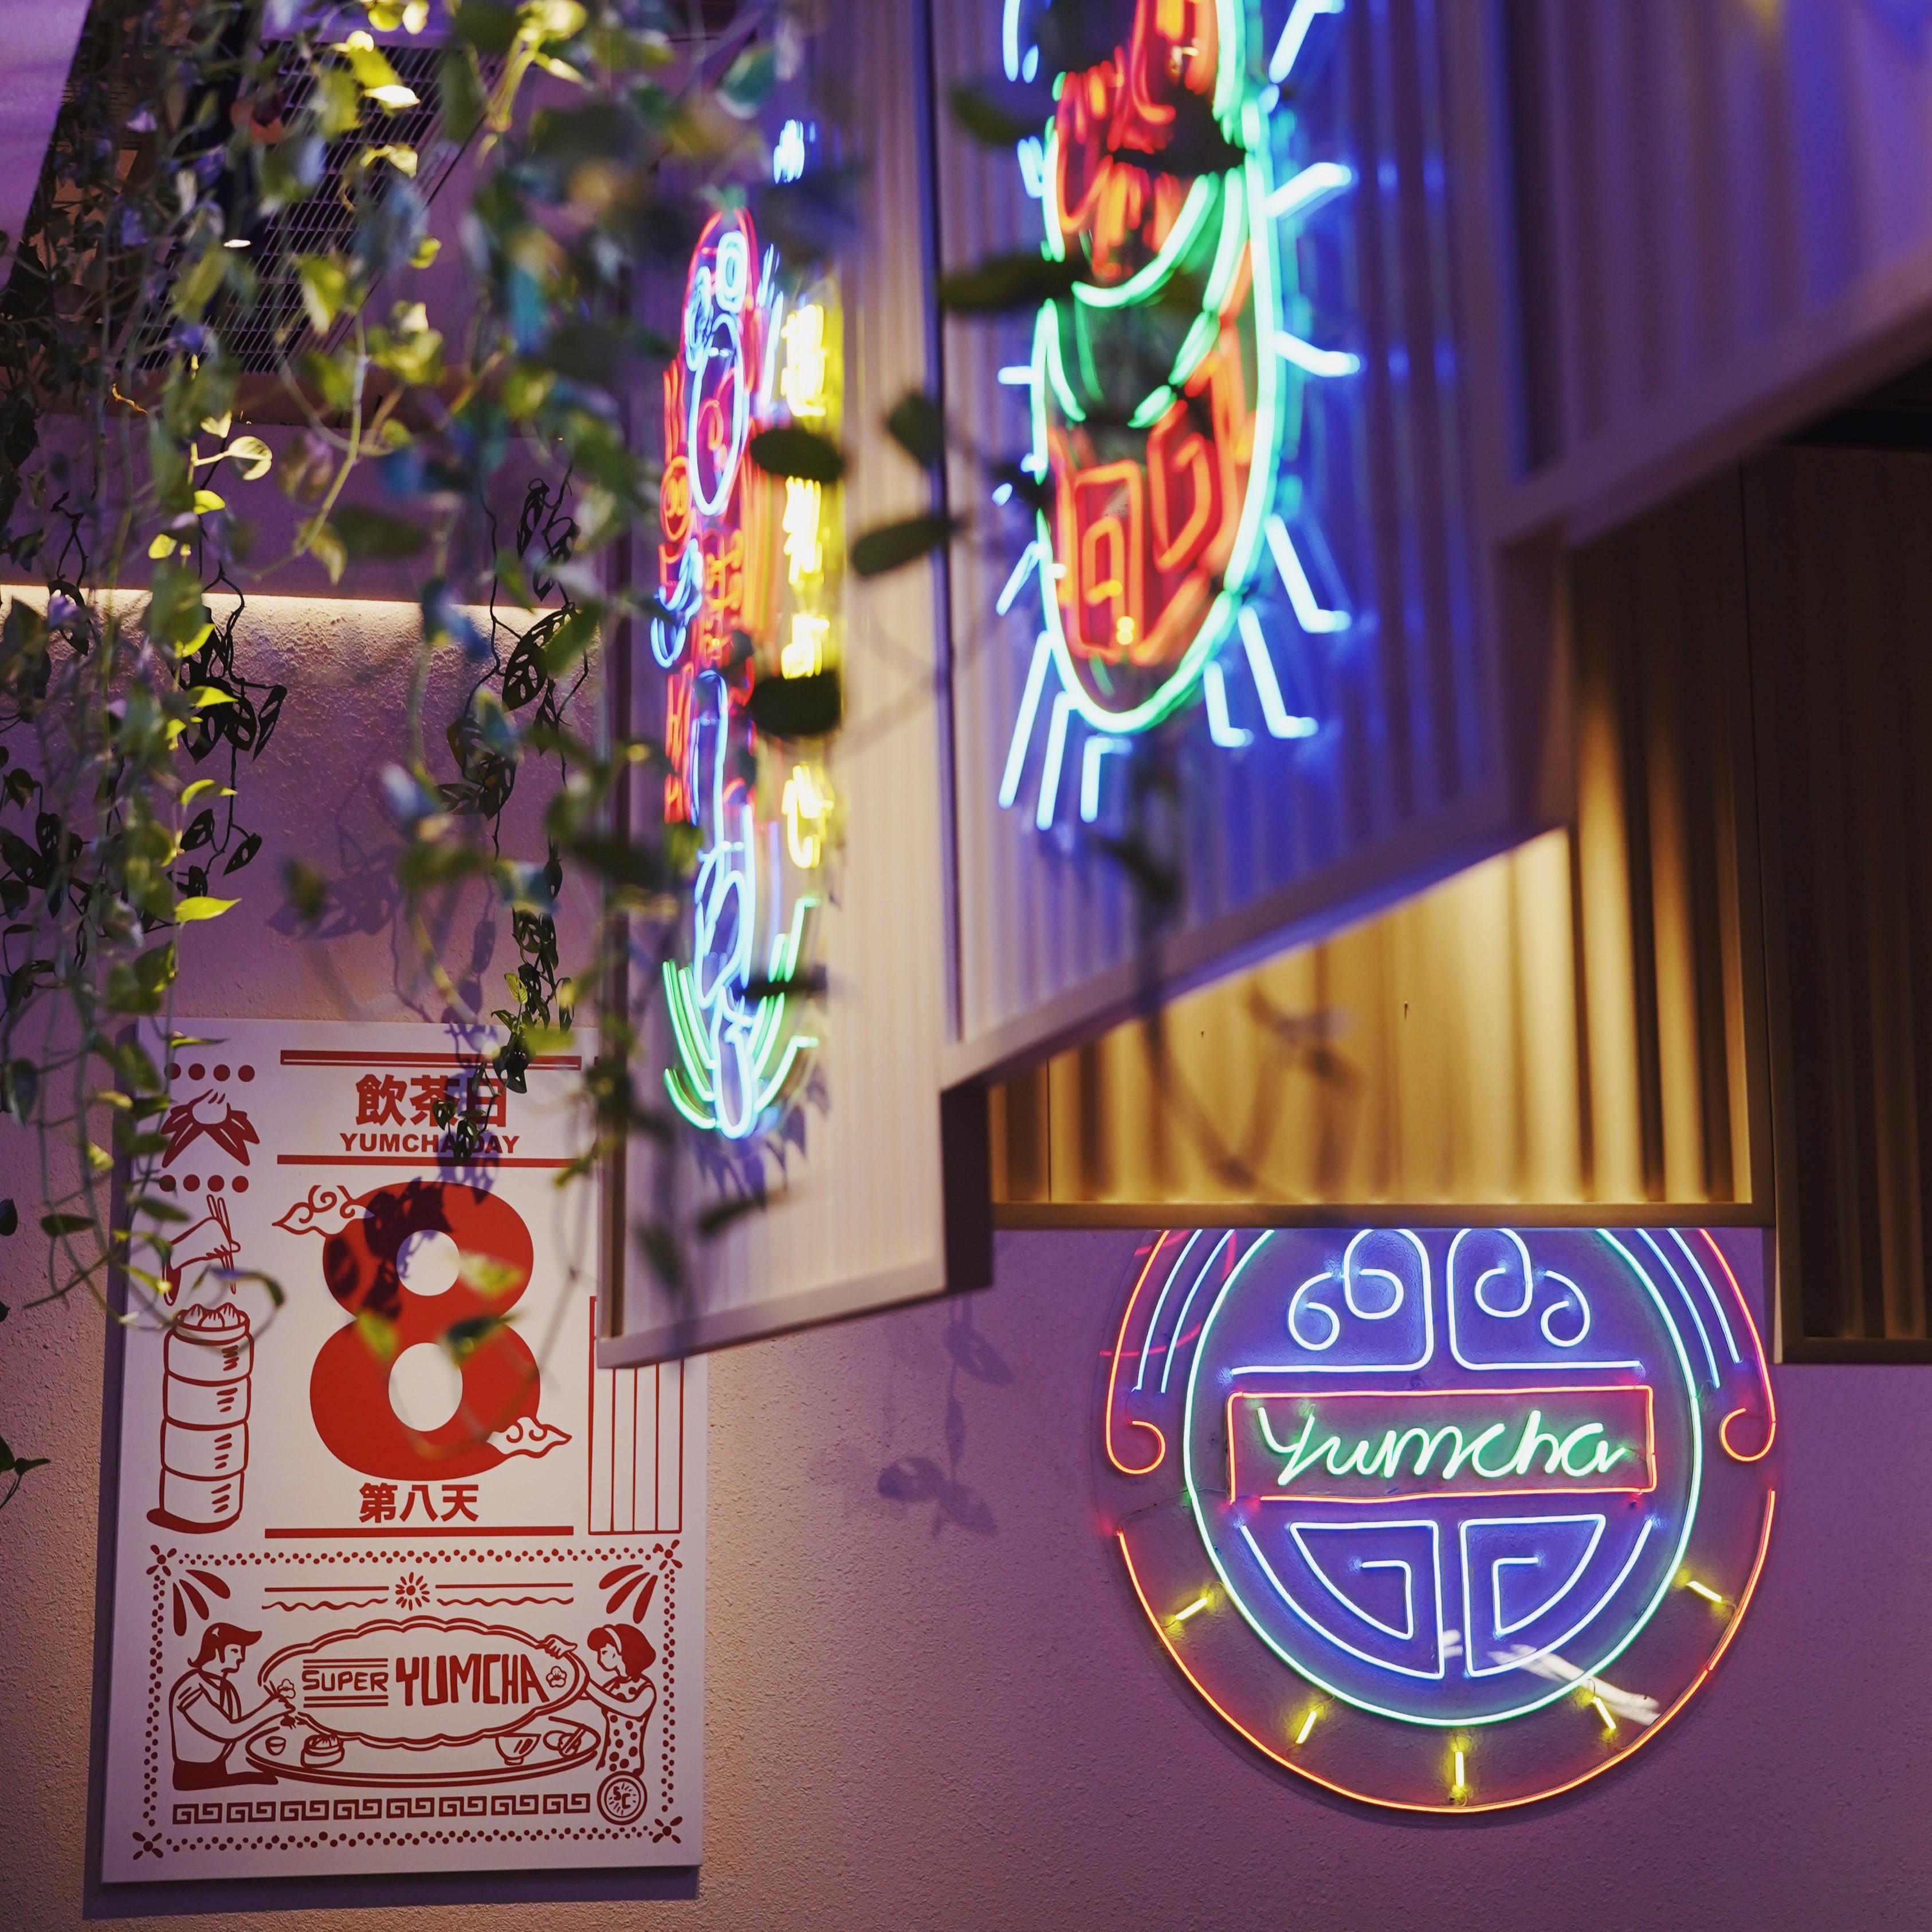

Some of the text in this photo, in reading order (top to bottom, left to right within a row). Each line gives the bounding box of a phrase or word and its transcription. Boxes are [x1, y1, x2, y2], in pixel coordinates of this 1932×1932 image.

[355, 1073, 508, 1128] 飲茶日
[310, 1181, 540, 1481] 8
[1256, 1404, 1629, 1486] Yumcha
[359, 1482, 479, 1523] 第八天
[301, 1654, 550, 1706] SUPER YUMCHA
